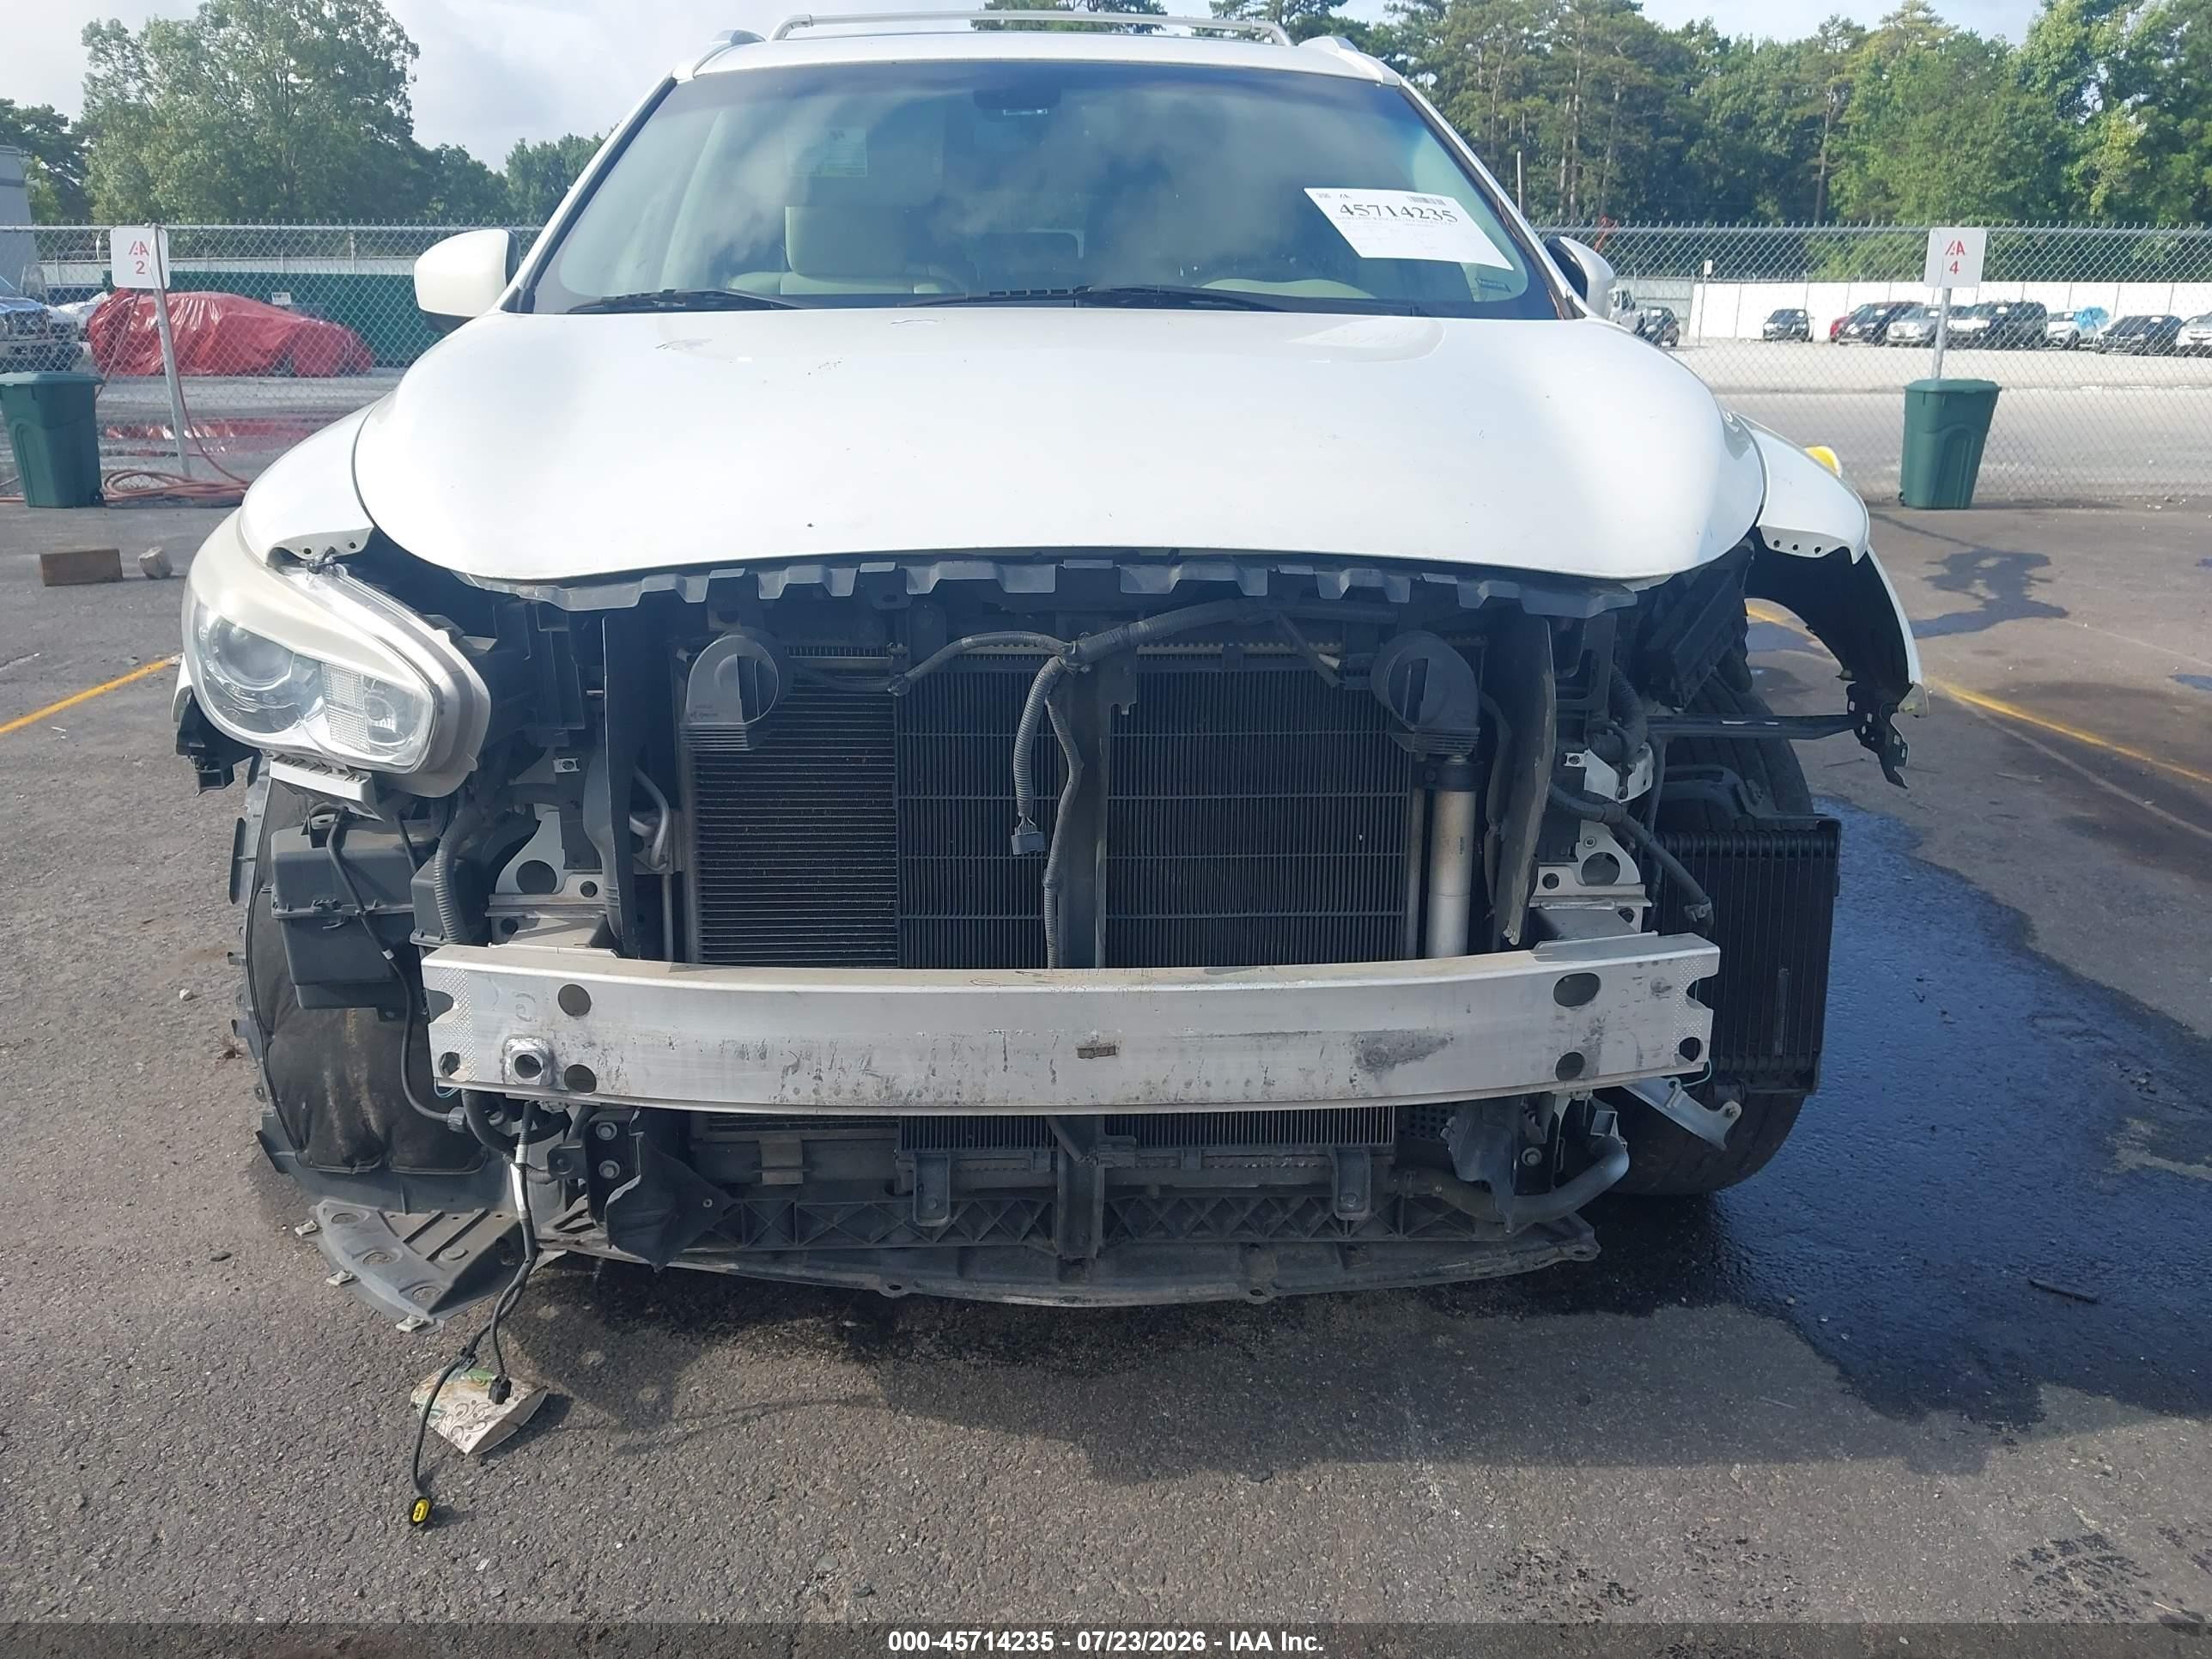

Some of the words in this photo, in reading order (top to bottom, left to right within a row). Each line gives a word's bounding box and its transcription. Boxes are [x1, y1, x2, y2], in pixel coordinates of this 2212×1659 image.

[1340, 204, 1458, 223] 45714235
[136, 260, 145, 275] 2
[1949, 260, 1959, 275] 4
